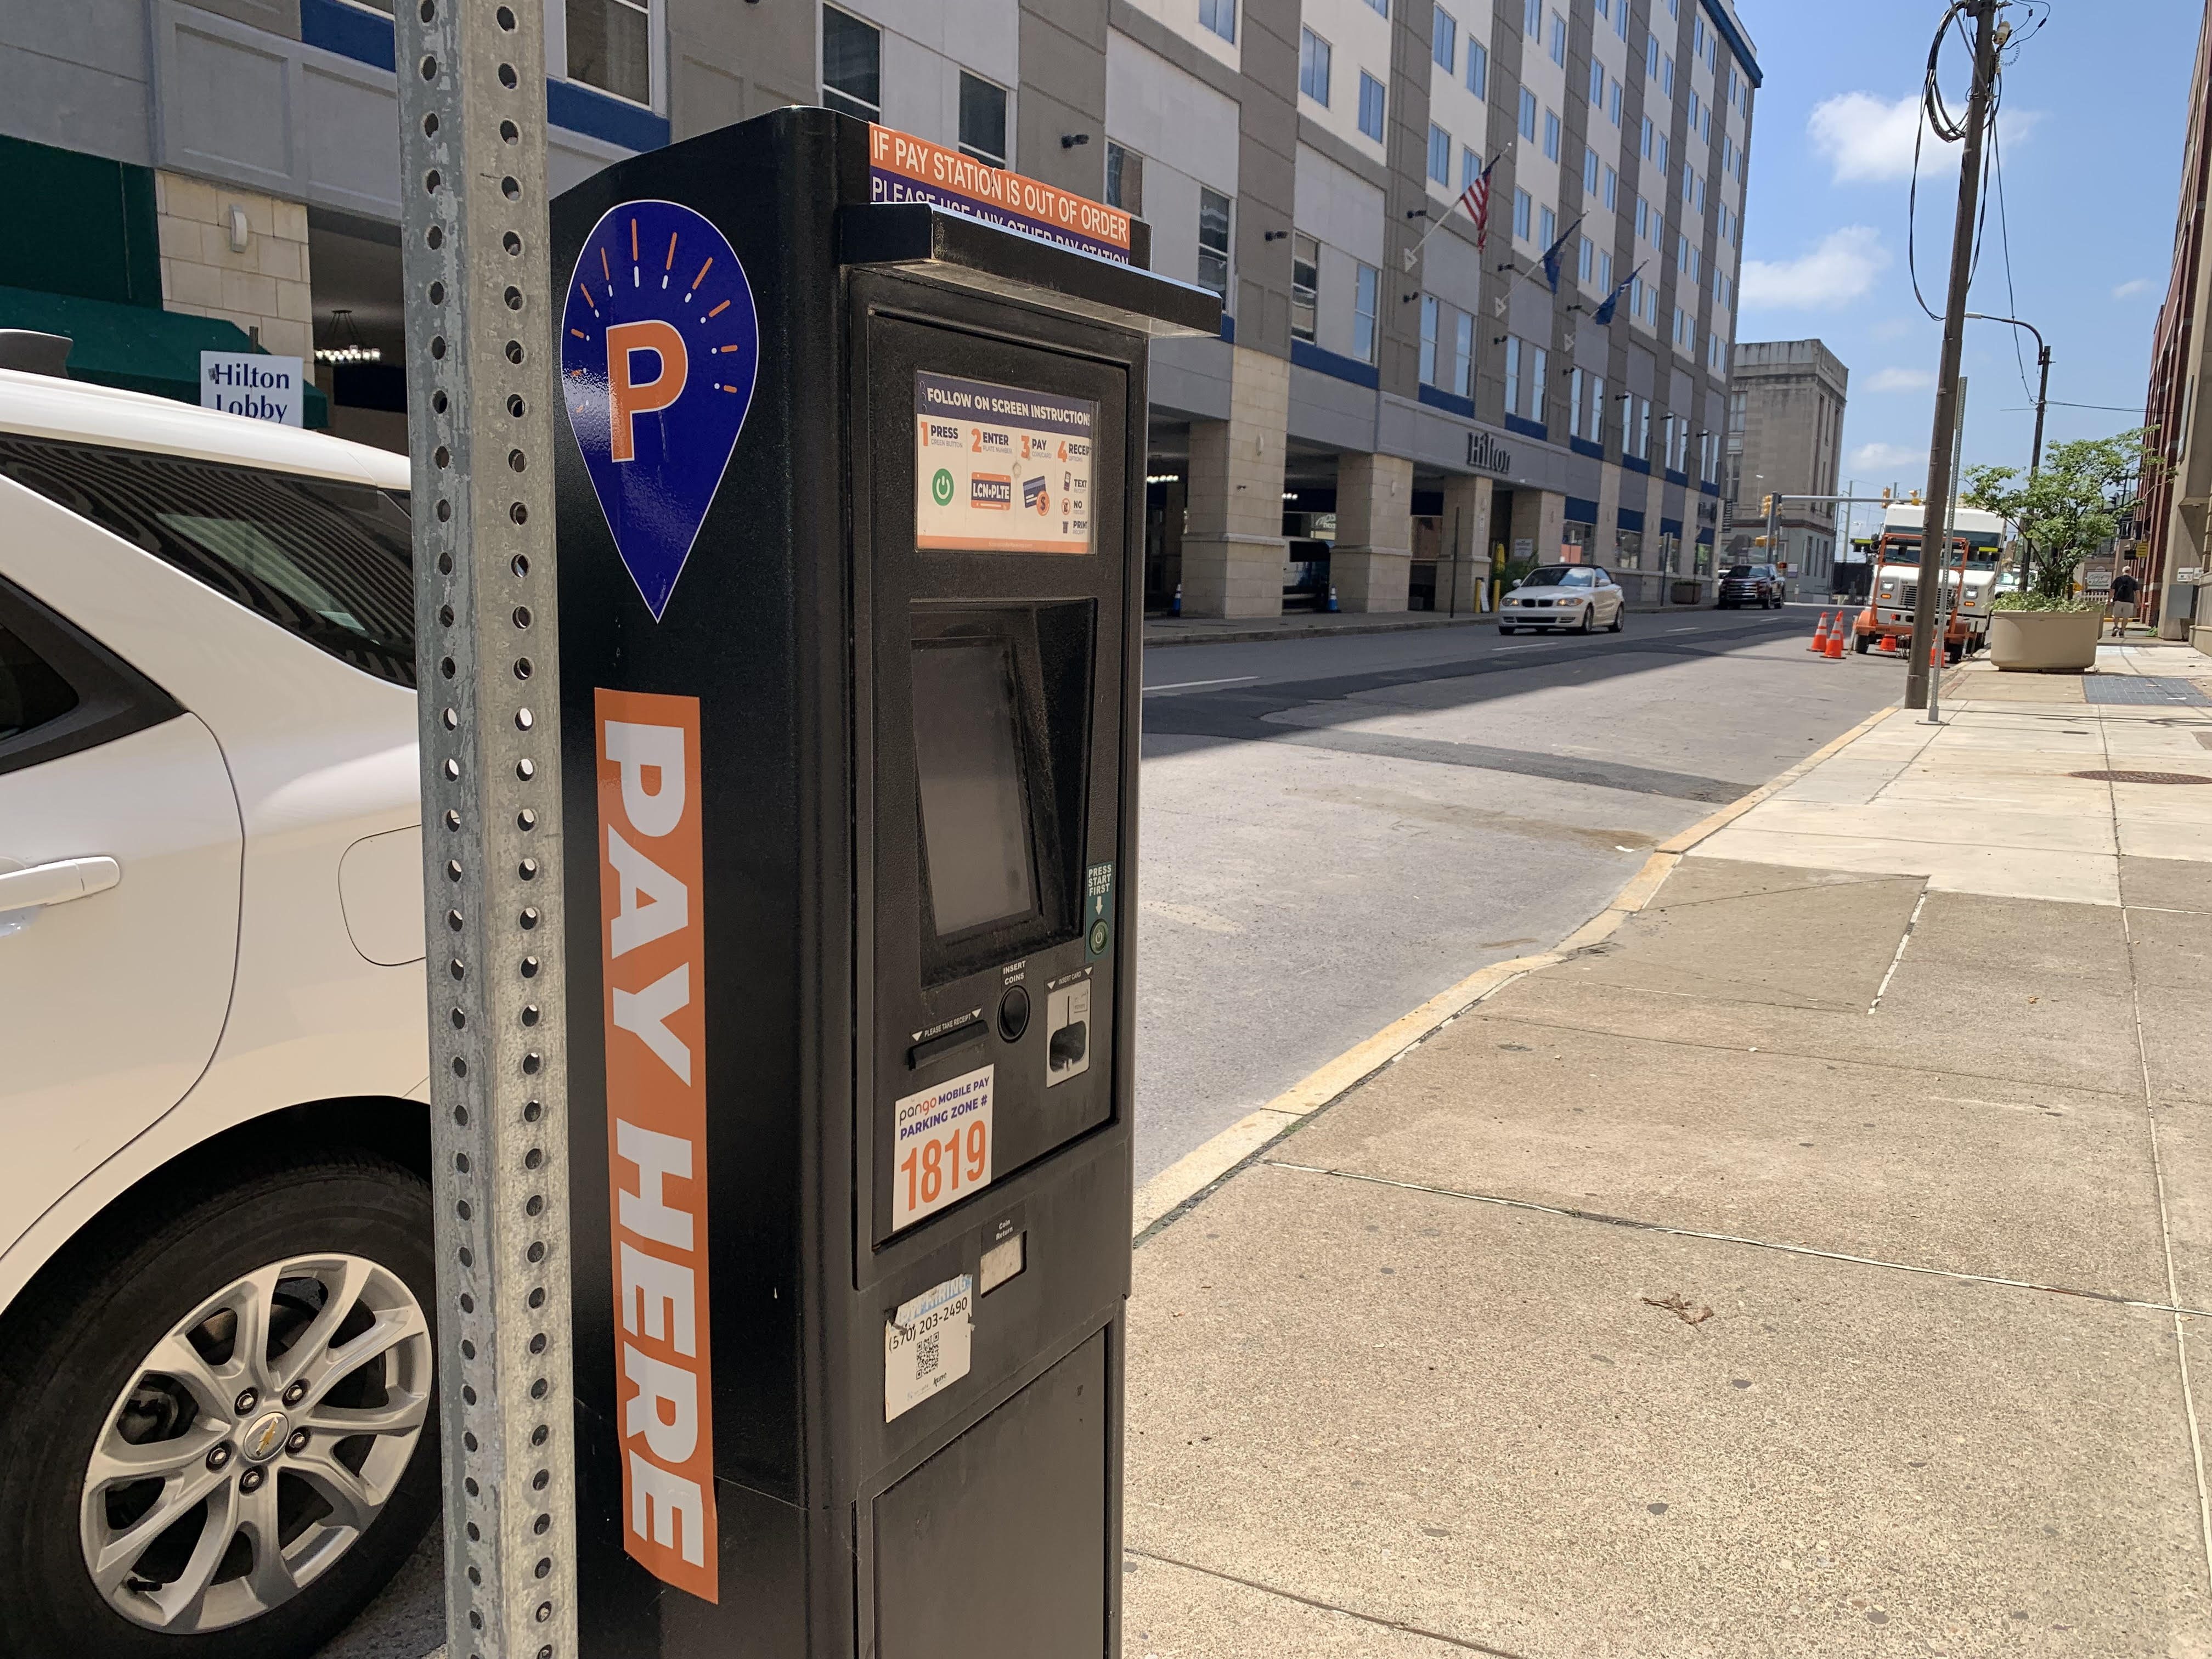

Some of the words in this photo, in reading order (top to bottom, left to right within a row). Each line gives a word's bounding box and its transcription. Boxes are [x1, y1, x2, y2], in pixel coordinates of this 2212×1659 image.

[873, 129, 889, 161] IF
[895, 138, 928, 174] PAY
[934, 152, 1002, 200] STATION
[1006, 177, 1020, 206] IS
[1024, 185, 1054, 217] OUT
[1058, 196, 1077, 224] OF
[1081, 205, 1127, 242] ORDER
[215, 363, 290, 389] Hilton
[606, 319, 689, 463] P
[927, 387, 972, 407] FOLLOW
[974, 396, 990, 410] ON
[992, 398, 1029, 417] SCREEN
[921, 421, 928, 447] 1
[930, 425, 958, 439] PRESS
[971, 428, 982, 453] 2
[983, 432, 1009, 446] ENTER
[1021, 435, 1030, 459] 3
[1031, 438, 1047, 450] PAY
[1057, 441, 1068, 462] 4
[1467, 431, 1510, 474] Hilton
[1074, 479, 1087, 488] TEXT
[1073, 500, 1082, 509] NO
[1088, 864, 1112, 878] PRESS
[1088, 873, 1111, 887] START
[1089, 883, 1110, 896] FIRST
[605, 719, 691, 1088] PAY
[1003, 961, 1026, 974] INSERT
[1005, 972, 1024, 985] COINS
[1058, 974, 1071, 985] INSERT
[1071, 970, 1081, 980] CARD
[924, 1024, 942, 1037] PLEASE
[942, 1020, 953, 1032] TAKE
[953, 1013, 971, 1029] RECEIPT
[899, 1097, 936, 1126] pango
[938, 1084, 971, 1105] MOBILE
[973, 1076, 990, 1091] PAY
[900, 1110, 948, 1141] PARKING
[951, 1098, 978, 1119] ZONE
[981, 1094, 988, 1106] #
[901, 1120, 986, 1212] 1819
[996, 1226, 1013, 1241] Return
[998, 1218, 1011, 1231] Coin
[919, 1296, 967, 1335] 203-2490
[617, 1118, 705, 1569] HERE
